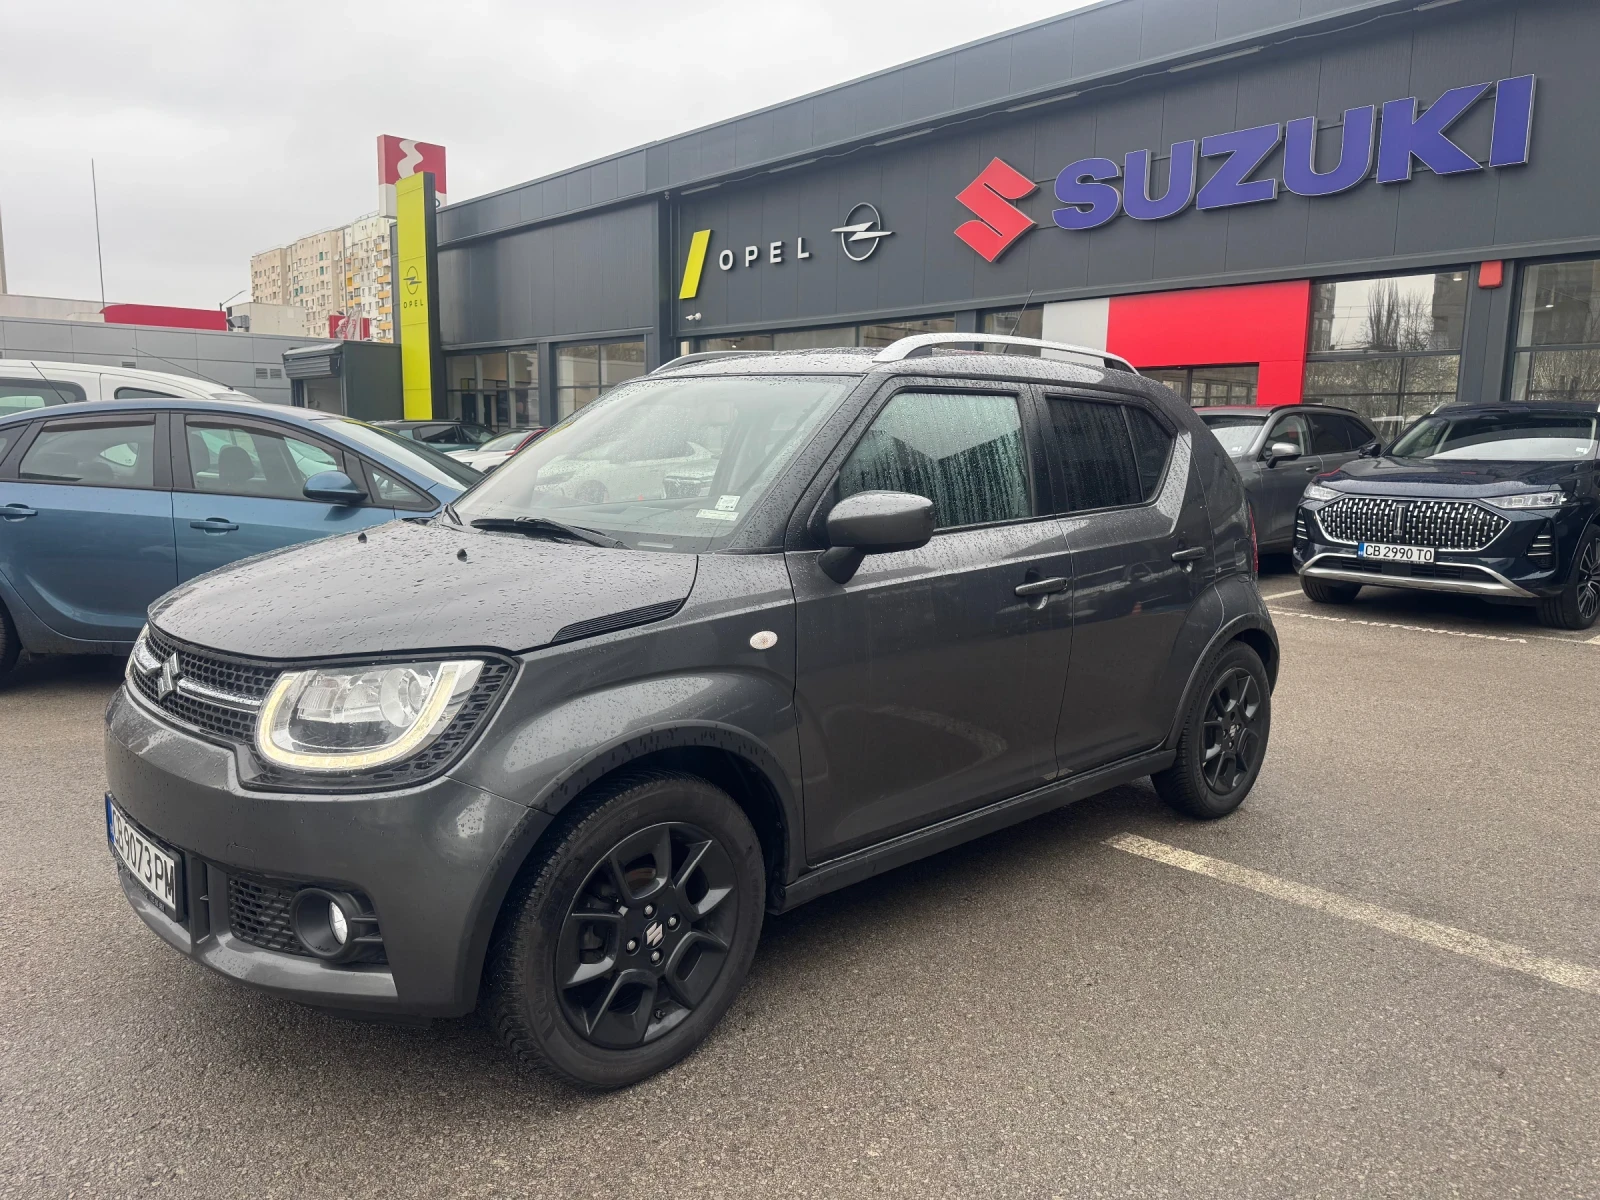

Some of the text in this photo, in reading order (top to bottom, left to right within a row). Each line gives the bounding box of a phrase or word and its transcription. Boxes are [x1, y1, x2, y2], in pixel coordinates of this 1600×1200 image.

[1052, 74, 1535, 230] SUZUKI
[719, 237, 810, 271] OPEL
[403, 299, 424, 309] OPEL
[1365, 544, 1381, 557] CB
[1383, 546, 1413, 560] 2990
[1416, 548, 1433, 561] TO
[124, 825, 152, 883] 9073
[154, 852, 175, 905] PM
